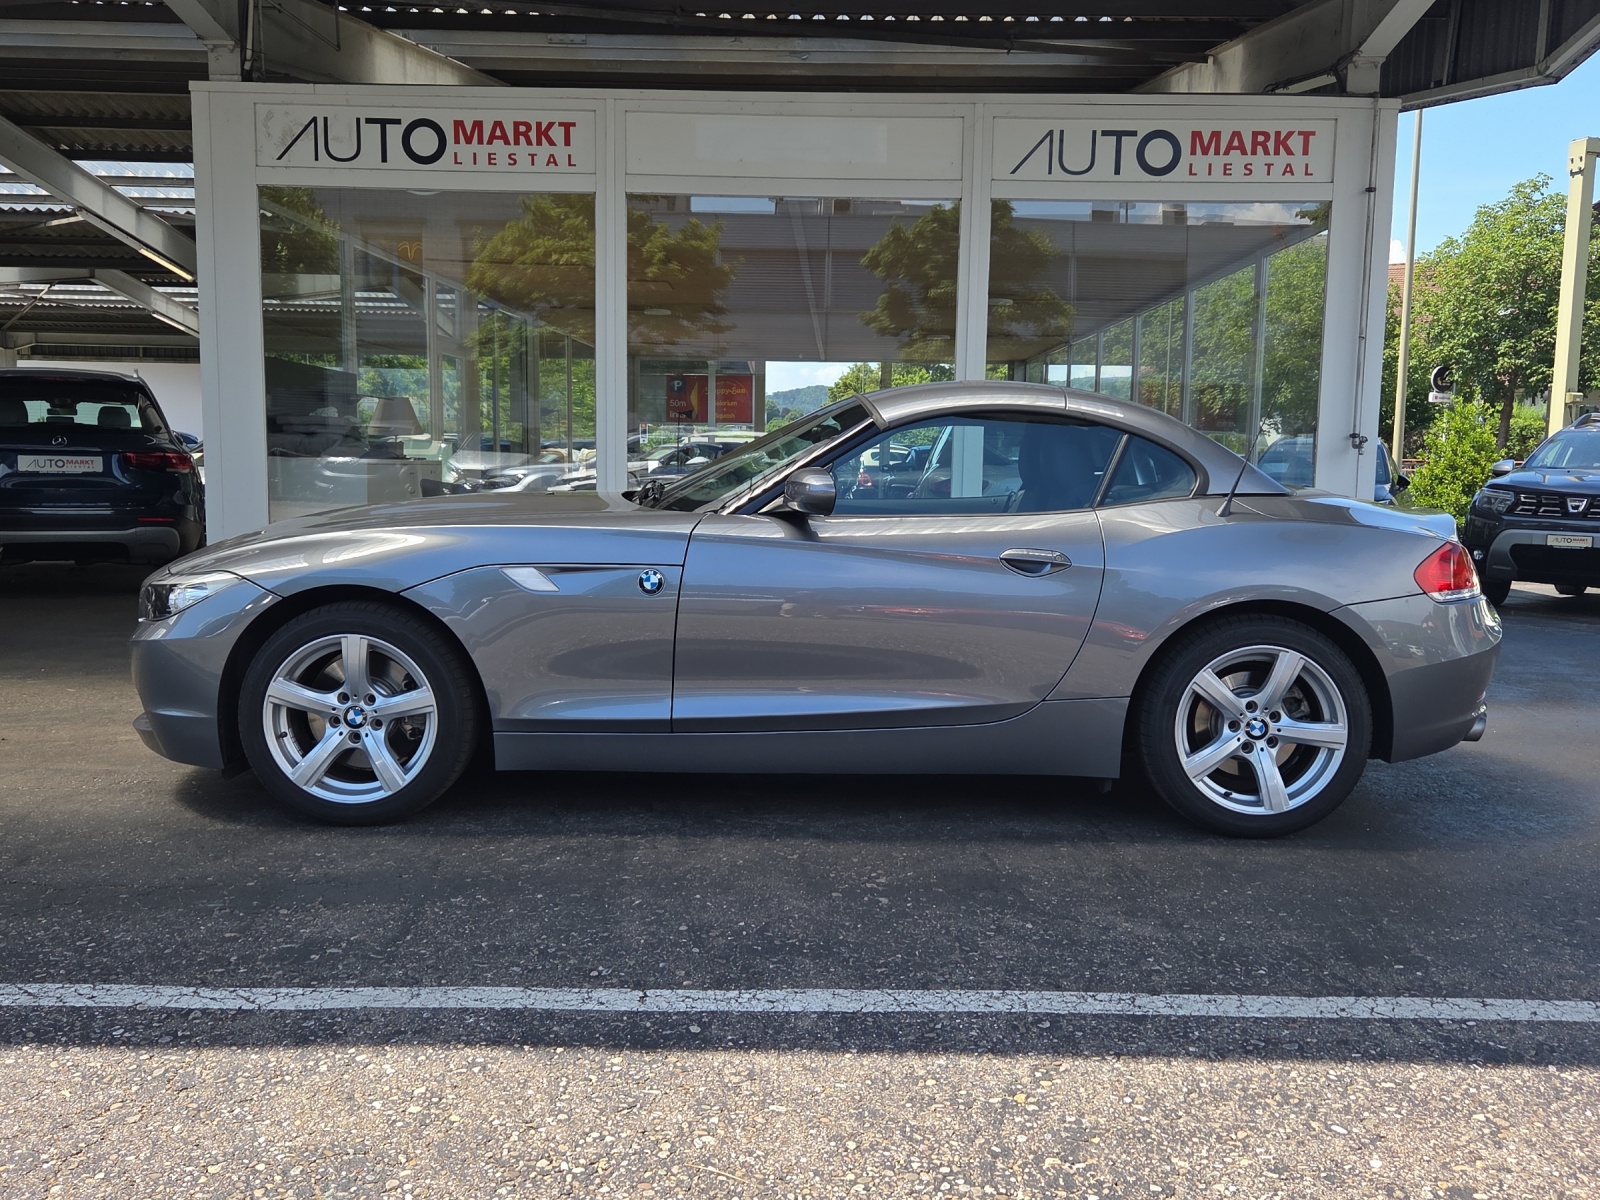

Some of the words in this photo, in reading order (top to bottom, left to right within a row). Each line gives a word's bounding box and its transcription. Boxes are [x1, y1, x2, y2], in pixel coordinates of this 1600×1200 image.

[277, 116, 447, 165] AUTO
[453, 119, 577, 147] MARKT
[453, 151, 577, 167] LIESTAL
[1010, 129, 1182, 177] AUTO
[1189, 130, 1316, 156] MARKT
[1188, 161, 1314, 177] LIESTAL
[669, 399, 687, 407] 50m
